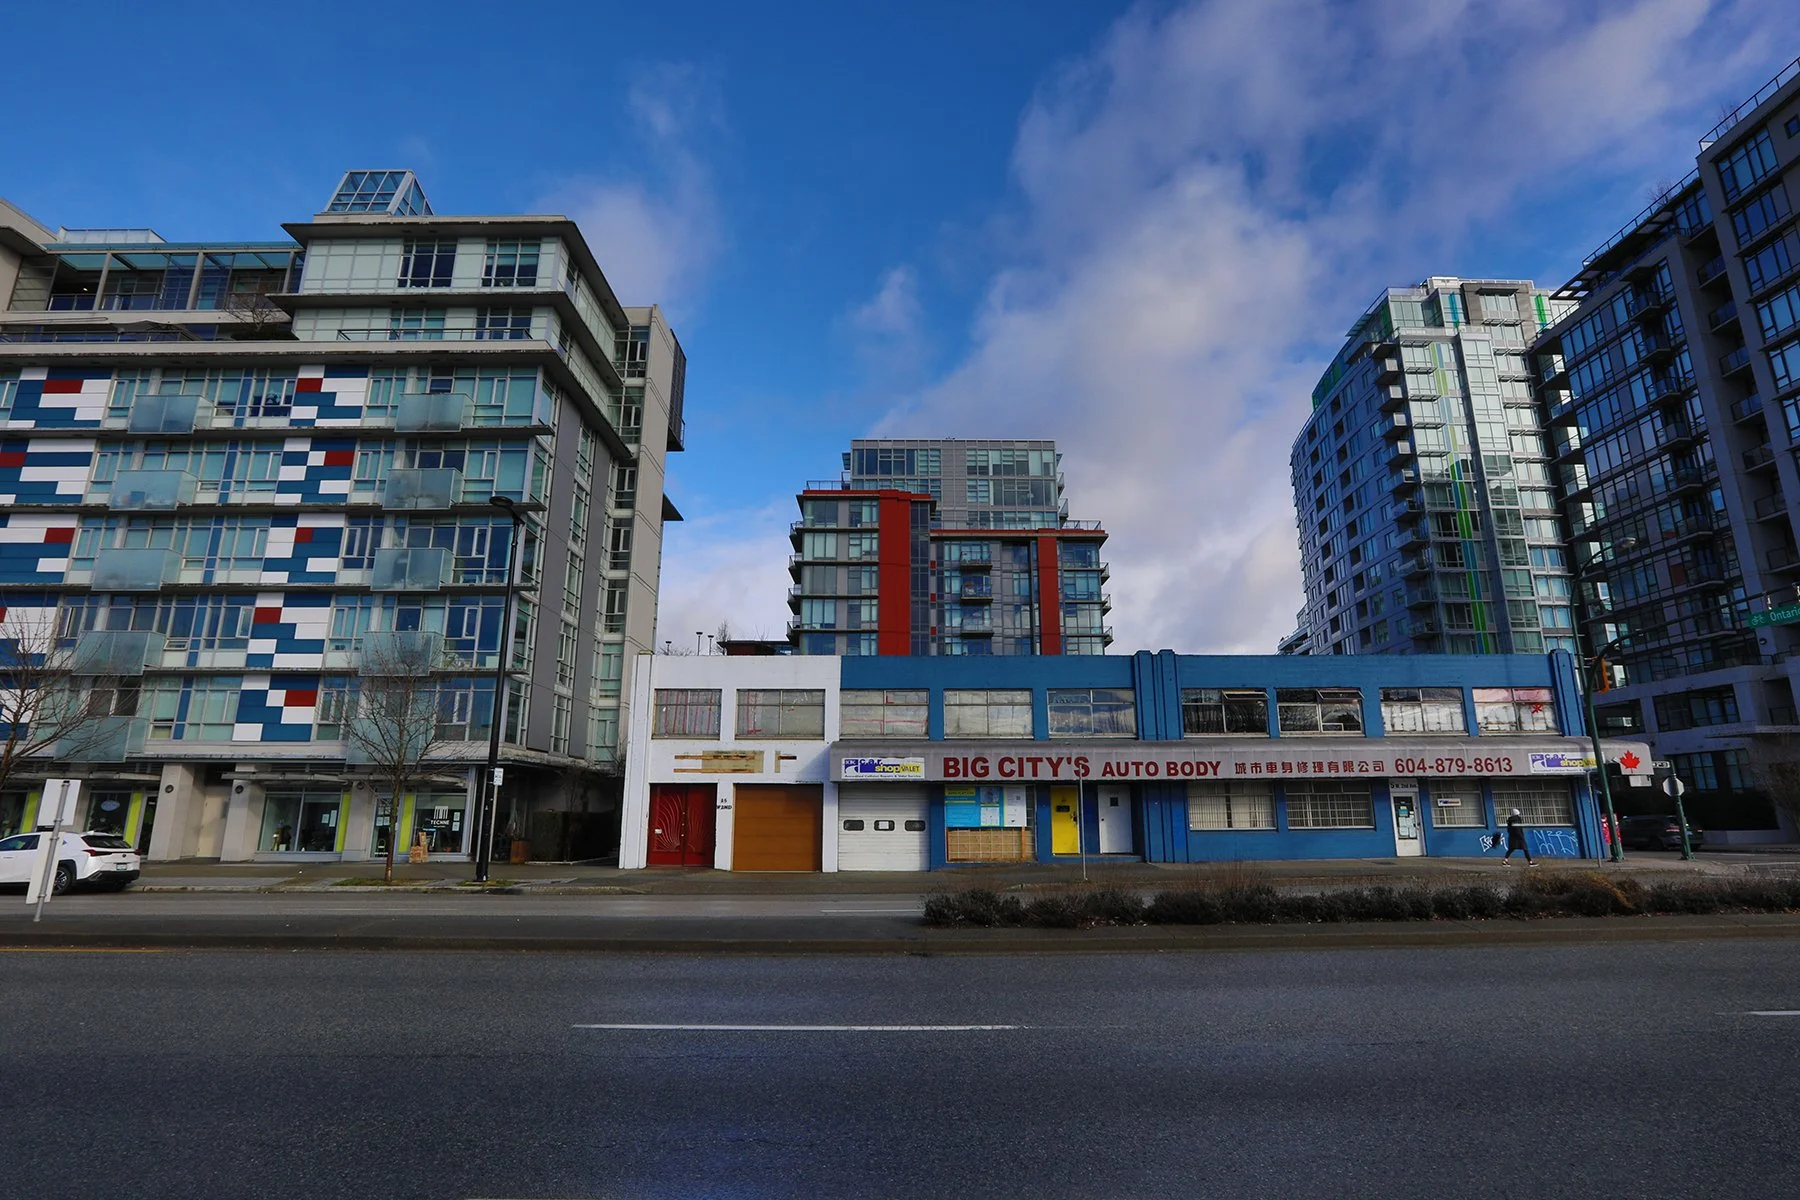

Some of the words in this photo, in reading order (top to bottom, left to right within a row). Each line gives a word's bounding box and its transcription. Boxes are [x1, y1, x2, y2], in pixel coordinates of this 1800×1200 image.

[875, 764, 900, 774] shop
[901, 765, 920, 773] VALET
[943, 757, 990, 778] BIG
[998, 756, 1090, 778] CITY'S
[1101, 761, 1160, 777] AUTO
[1166, 761, 1221, 777] BODY
[1235, 760, 1385, 775] 城市車身修理有限公司
[1394, 757, 1513, 773] 604-879-8613
[1560, 758, 1583, 768] shop
